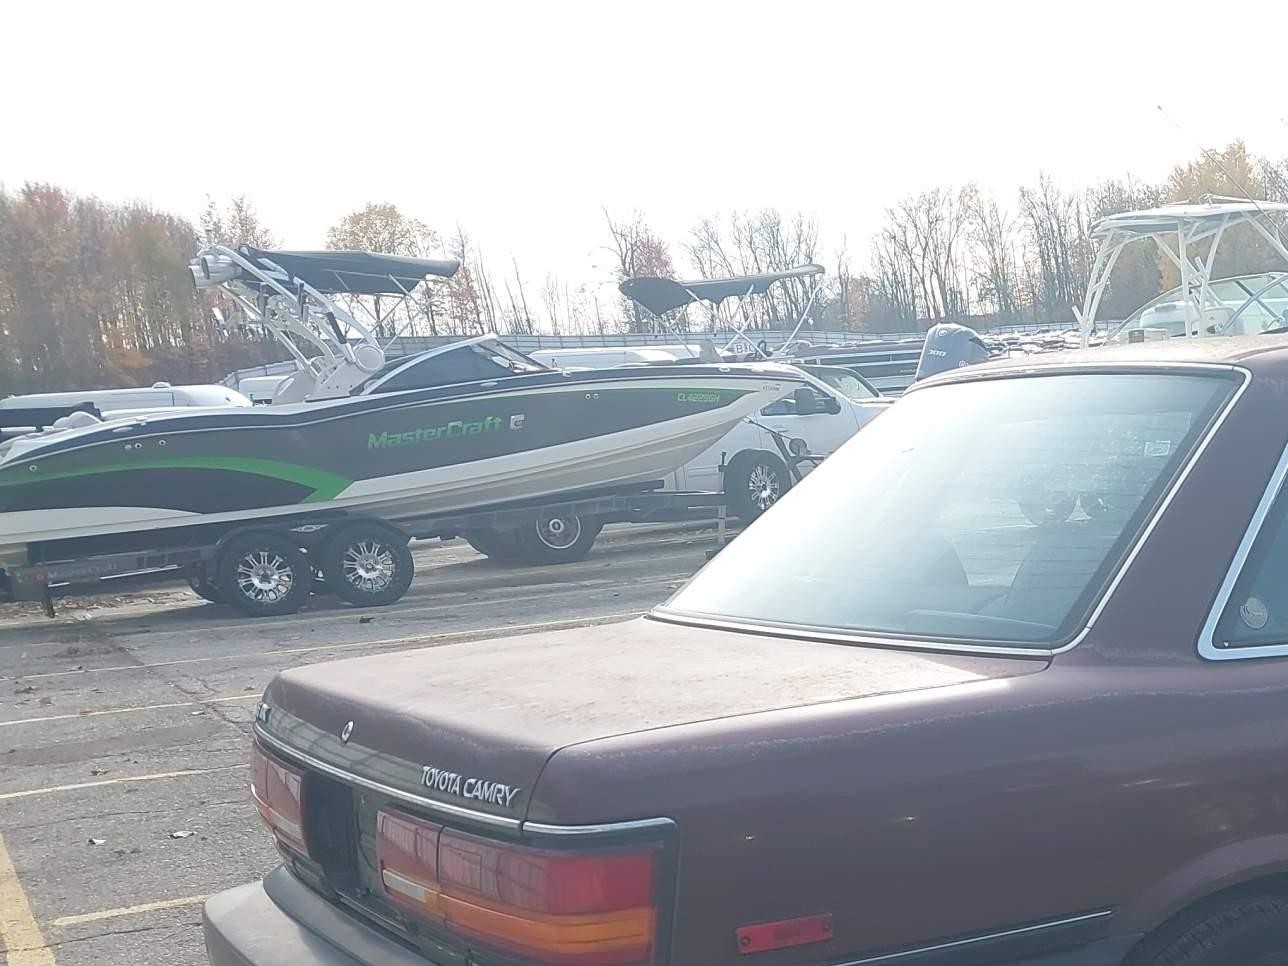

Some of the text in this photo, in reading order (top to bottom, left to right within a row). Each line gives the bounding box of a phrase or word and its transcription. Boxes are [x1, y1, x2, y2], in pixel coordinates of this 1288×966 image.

[367, 416, 502, 449] MasterCraft
[421, 766, 520, 807] TOYOTA CAMRY
